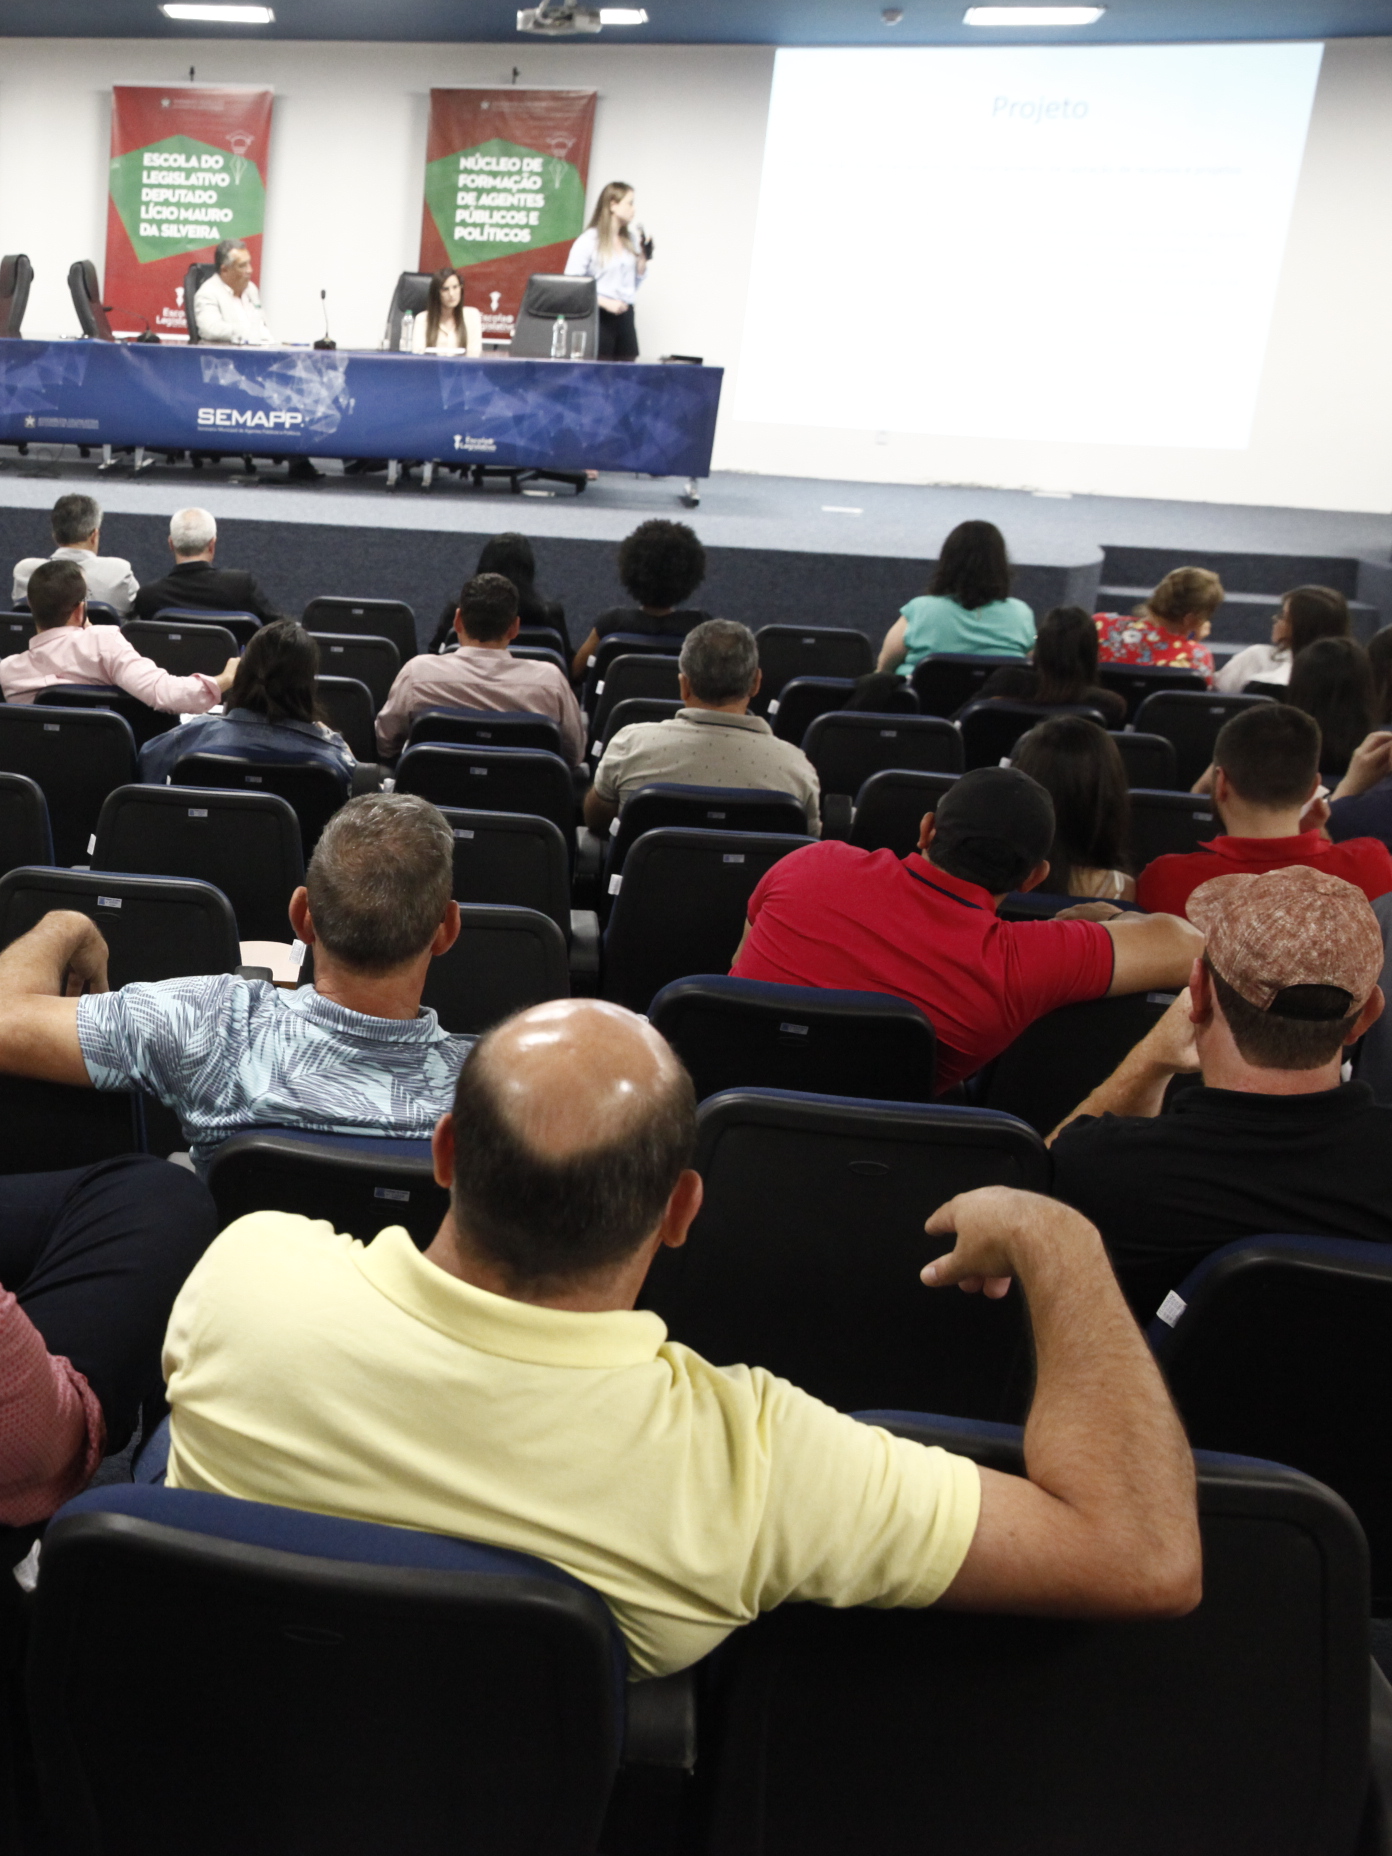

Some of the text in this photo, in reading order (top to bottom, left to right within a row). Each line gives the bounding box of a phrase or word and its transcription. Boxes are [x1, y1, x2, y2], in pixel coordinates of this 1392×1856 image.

[991, 95, 1089, 125] Projeto
[143, 152, 224, 169] ESCOLA DO
[459, 152, 544, 172] NÚCLEO DE
[142, 170, 230, 187] LEGISLATIVO
[458, 172, 542, 193] FORMAÇÃO
[141, 187, 218, 204] DEPUTADO
[456, 191, 545, 208] DE AGENTES
[140, 201, 233, 222] LÍCIO MAURO
[455, 205, 539, 226] PÚBLICOS E
[139, 222, 220, 239] DA SILVEIRA
[454, 224, 531, 243] POLÍTICOS
[197, 407, 302, 428] SEMAPP
